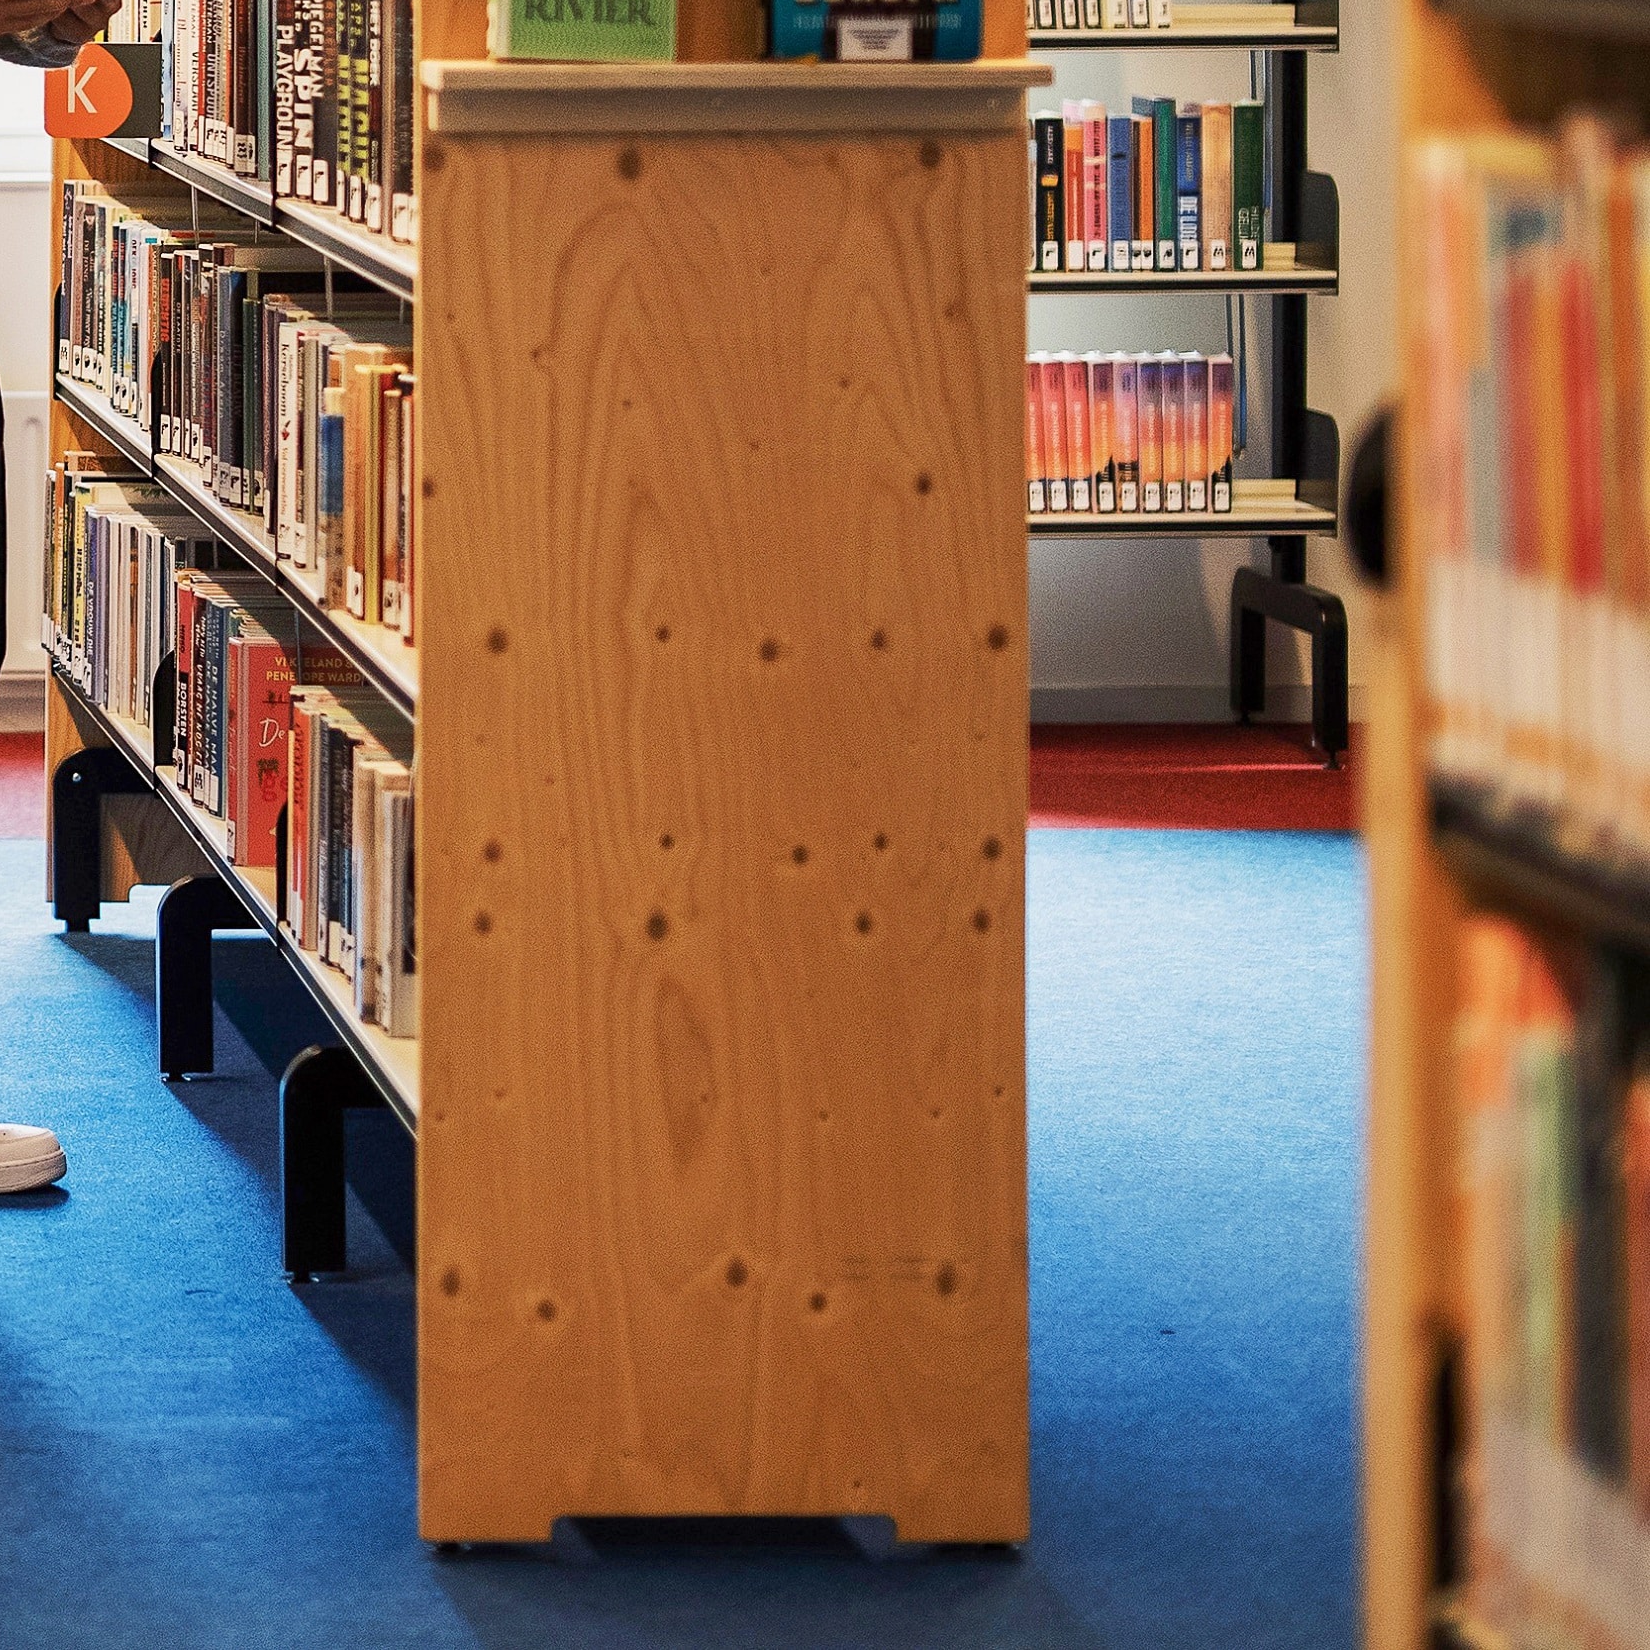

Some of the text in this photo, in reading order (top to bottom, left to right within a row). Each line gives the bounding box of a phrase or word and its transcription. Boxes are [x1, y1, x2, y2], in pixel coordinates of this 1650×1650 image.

[65, 66, 99, 114] K
[294, 48, 314, 148] SPIN
[281, 343, 290, 417] Kerseboom
[211, 665, 218, 685] DE
[266, 670, 362, 682] PENEOPE WARD
[275, 657, 343, 669] VI KELAND
[180, 681, 188, 737] BORSTEN
[258, 717, 286, 748] De
